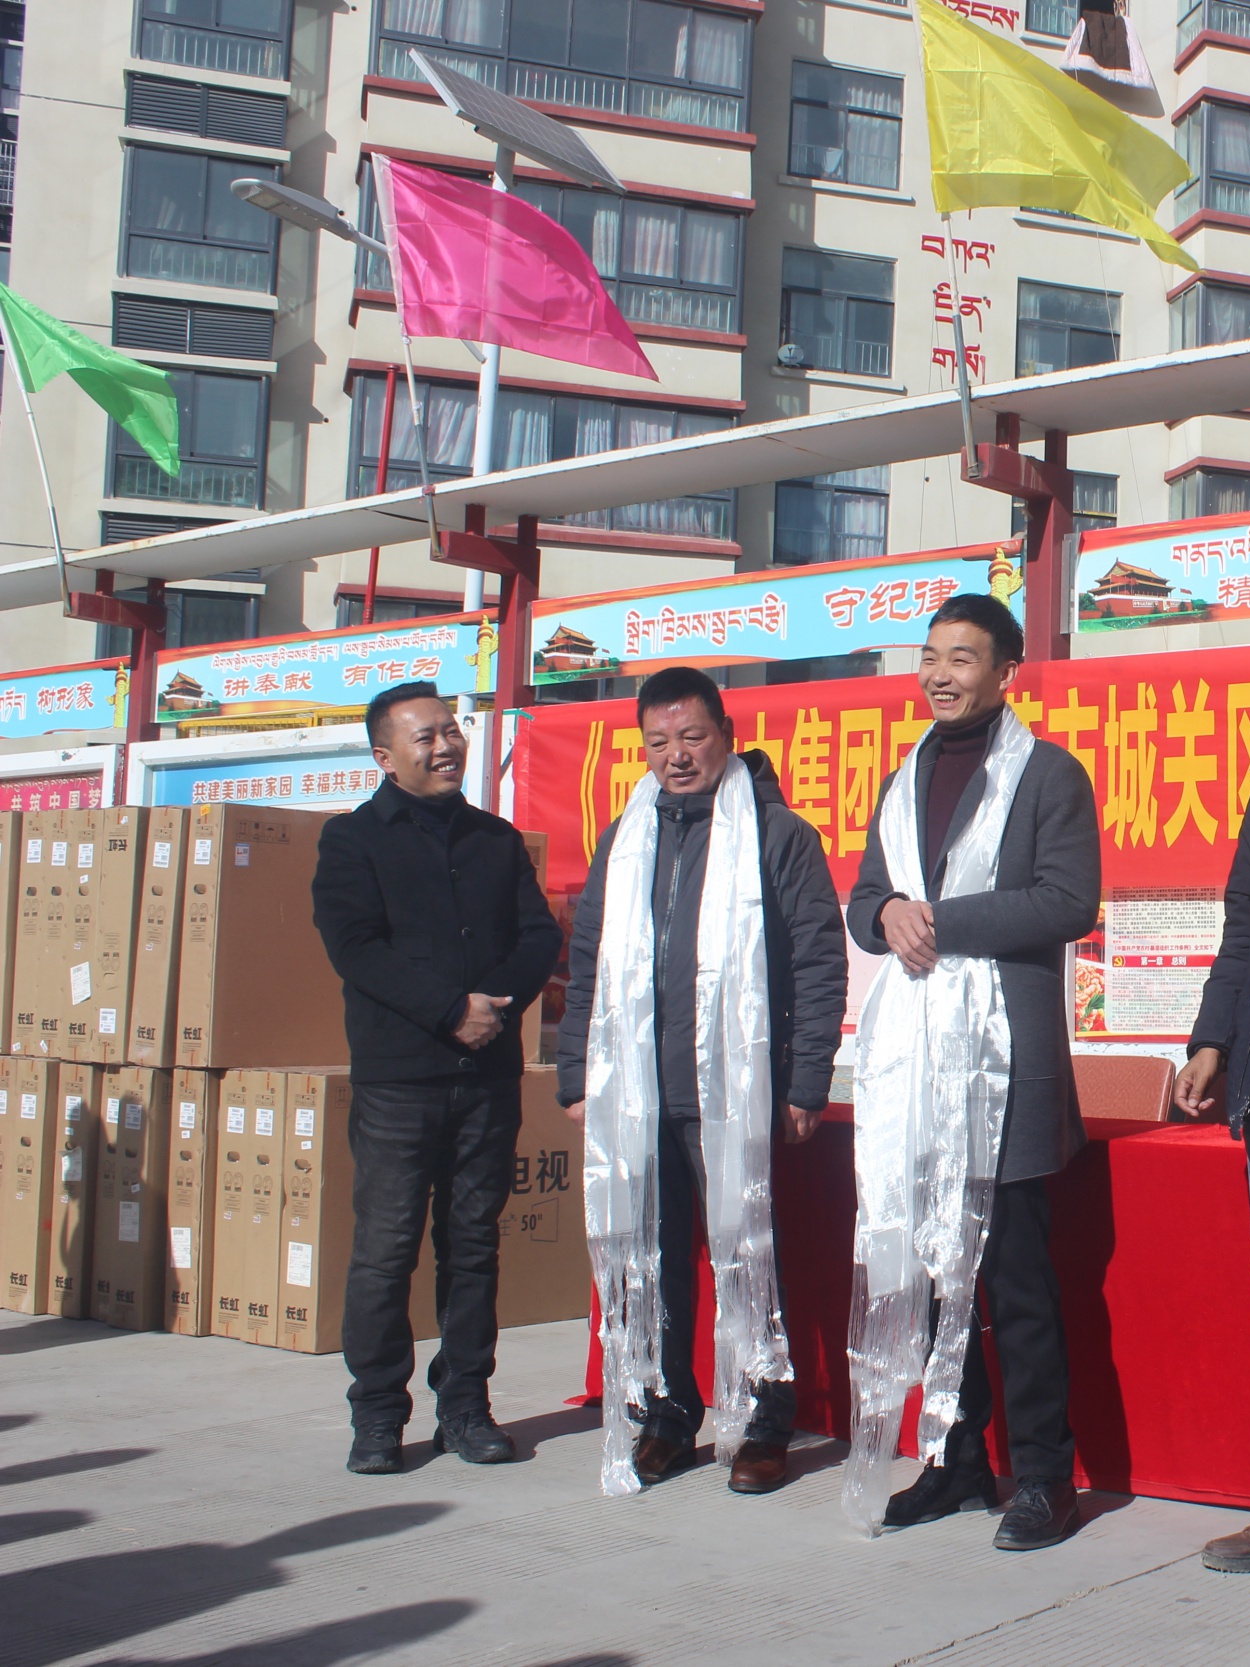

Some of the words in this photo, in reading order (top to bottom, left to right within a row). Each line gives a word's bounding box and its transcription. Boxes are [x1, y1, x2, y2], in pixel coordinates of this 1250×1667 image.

[825, 578, 959, 627] 守纪律
[224, 673, 313, 698] 讲奉献
[343, 657, 443, 687] 有作为
[37, 682, 94, 713] 树形象
[193, 776, 293, 802] 共建美丽新家园
[301, 769, 385, 794] 幸福共享同
[1140, 956, 1164, 966] 第一章
[1170, 956, 1187, 966] 总则
[18, 1013, 33, 1025] 长虹
[41, 1018, 58, 1031] 长虹
[69, 1023, 86, 1035] 长虹
[137, 1025, 156, 1040] 长虹
[183, 1027, 202, 1040] 长虹
[511, 1150, 570, 1195] 电视
[10, 1272, 28, 1287] 长虹
[55, 1275, 73, 1290] 长虹
[115, 1289, 135, 1304] 长虹
[171, 1290, 190, 1305] 长虹
[219, 1296, 240, 1312] 长虹
[248, 1302, 269, 1318] 长虹
[285, 1306, 308, 1322] 长虹
